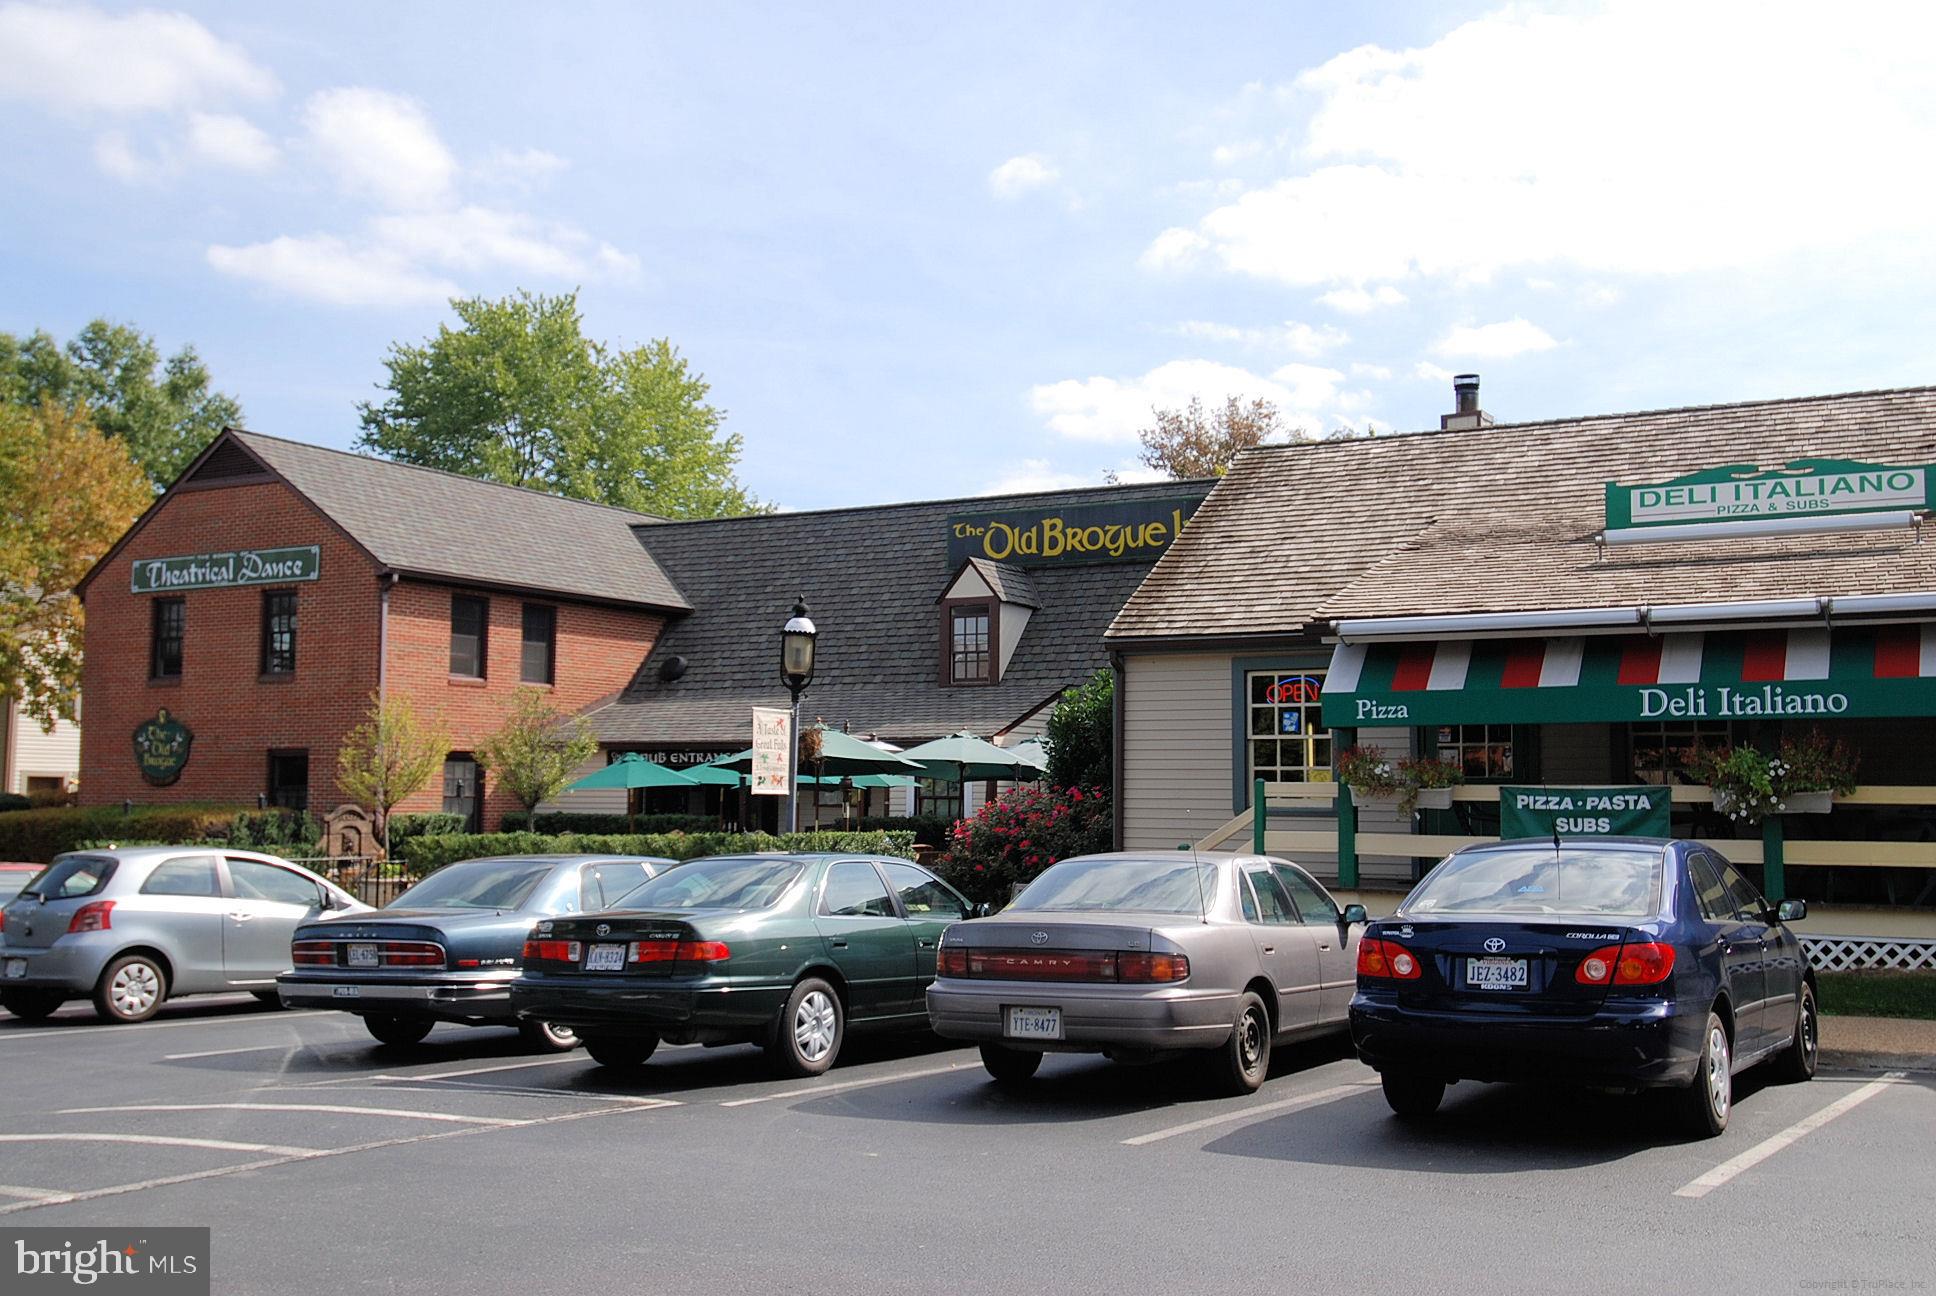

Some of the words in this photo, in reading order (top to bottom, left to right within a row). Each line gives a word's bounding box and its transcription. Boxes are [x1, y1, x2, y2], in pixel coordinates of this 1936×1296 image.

[1639, 486, 1716, 508] DELI
[1734, 472, 1916, 501] ITALIANO
[1717, 503, 1760, 515] PIZZA
[1768, 502, 1777, 511] &
[1786, 498, 1830, 511] SUBS
[953, 522, 985, 538] The
[983, 521, 1038, 559] Old
[146, 558, 234, 588] Theatrical
[237, 553, 303, 584] Dance
[1266, 683, 1319, 703] OPEN
[1356, 699, 1408, 719] Pizza
[1638, 687, 1707, 717] Deli
[1717, 685, 1848, 716] Italiano
[1516, 795, 1574, 810] PIZZA
[1586, 795, 1651, 810] PASTA
[1555, 817, 1611, 833] SUBS
[1565, 932, 1606, 940] COROLLA
[1006, 958, 1072, 967] CAMRY
[1470, 966, 1525, 982] JEZ-3482
[1480, 983, 1513, 991] KOONS
[1013, 1017, 1057, 1032] YTE-8477
